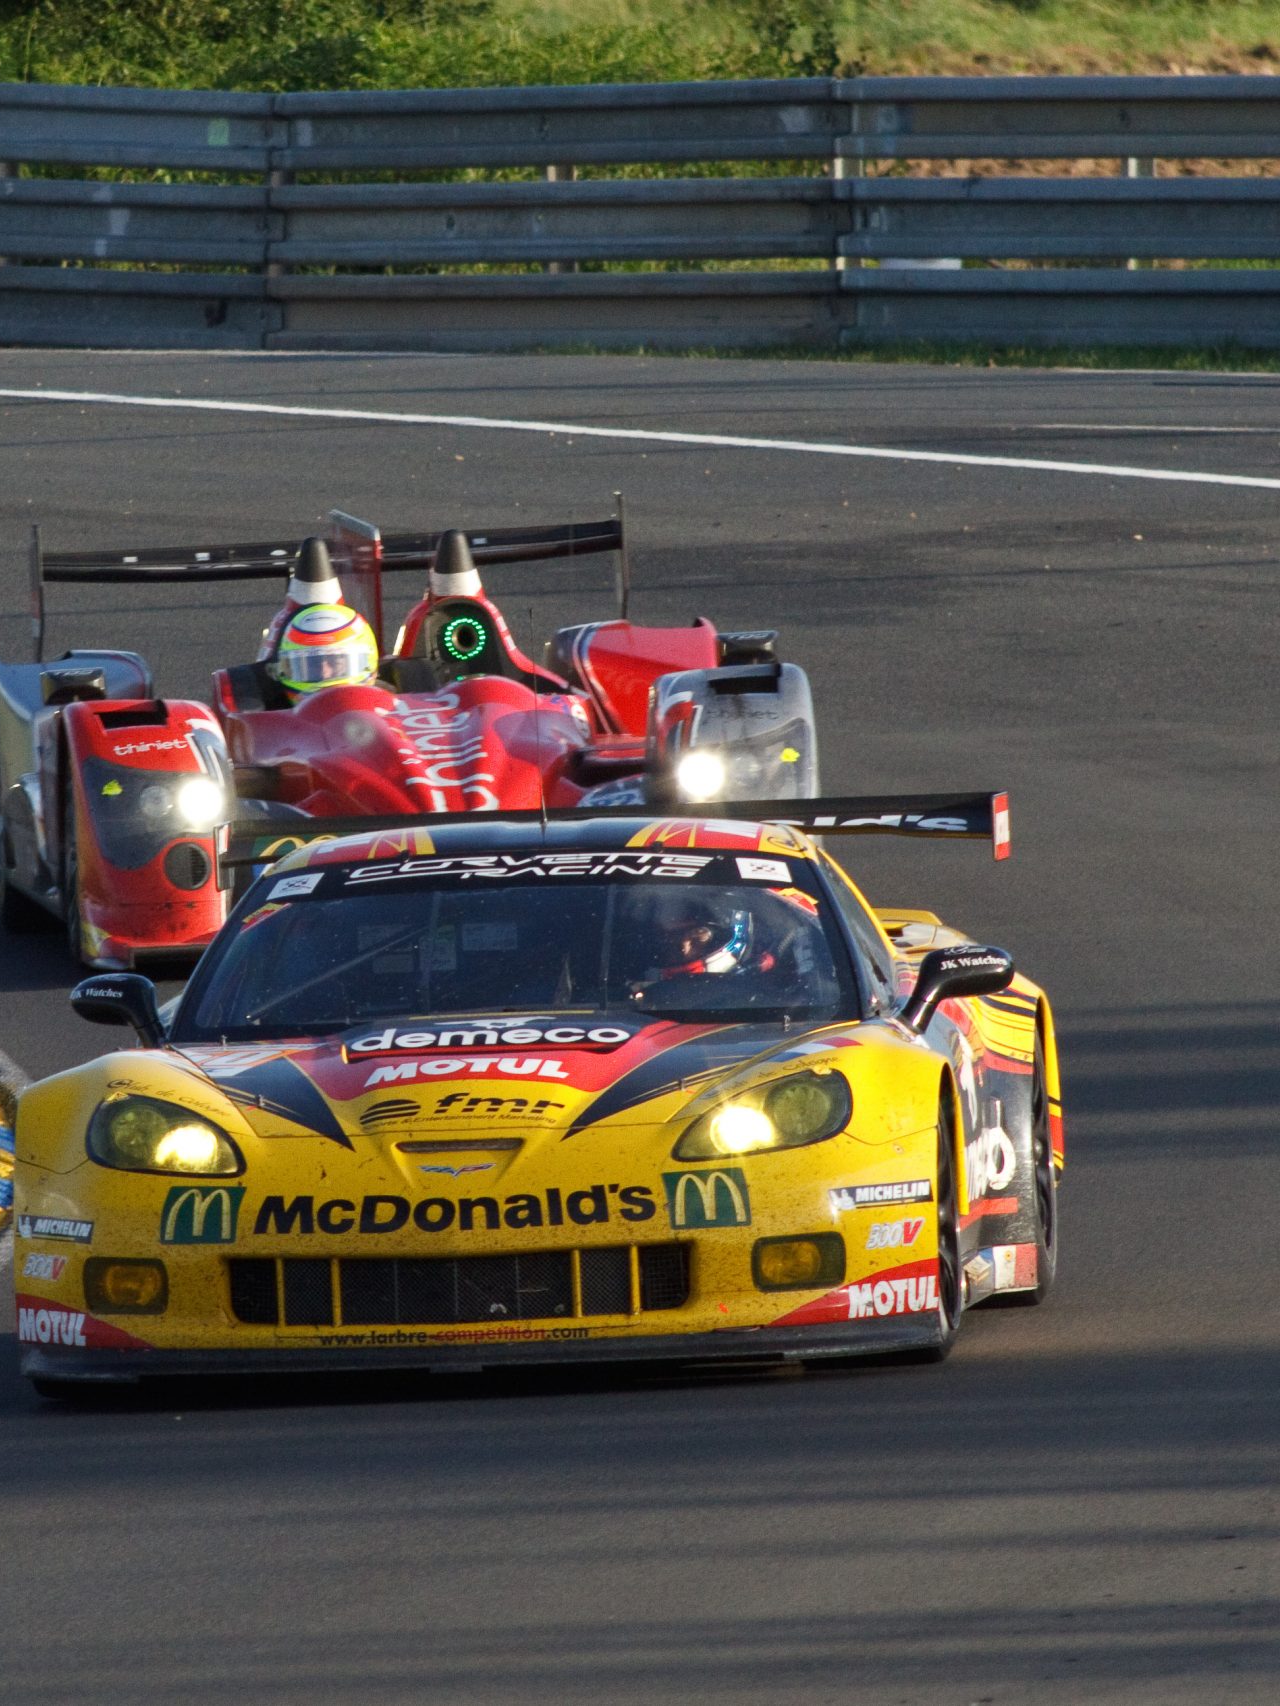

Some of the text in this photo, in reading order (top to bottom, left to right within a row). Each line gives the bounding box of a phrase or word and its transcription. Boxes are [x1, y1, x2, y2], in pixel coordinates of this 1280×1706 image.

[113, 738, 190, 756] thiriet
[348, 852, 715, 882] CORVETTE
[460, 864, 703, 880] RACING
[940, 955, 1009, 971] JK Watches
[85, 987, 124, 998] Watches
[351, 1028, 630, 1052] demeco
[364, 1058, 570, 1088] MOTUL
[435, 1092, 566, 1114] fmr
[412, 1114, 496, 1125] Entertainment
[499, 1113, 558, 1124] Marketing
[855, 1181, 931, 1202] MICHELIN
[254, 1183, 656, 1235] McDonald's
[34, 1218, 92, 1237] MICHELIN
[866, 1217, 926, 1249] 300V
[23, 1253, 68, 1281] 300V
[848, 1275, 940, 1319] MOTUL
[19, 1308, 86, 1346] MOTUL
[321, 1327, 590, 1347] www.larbre-competition.com
